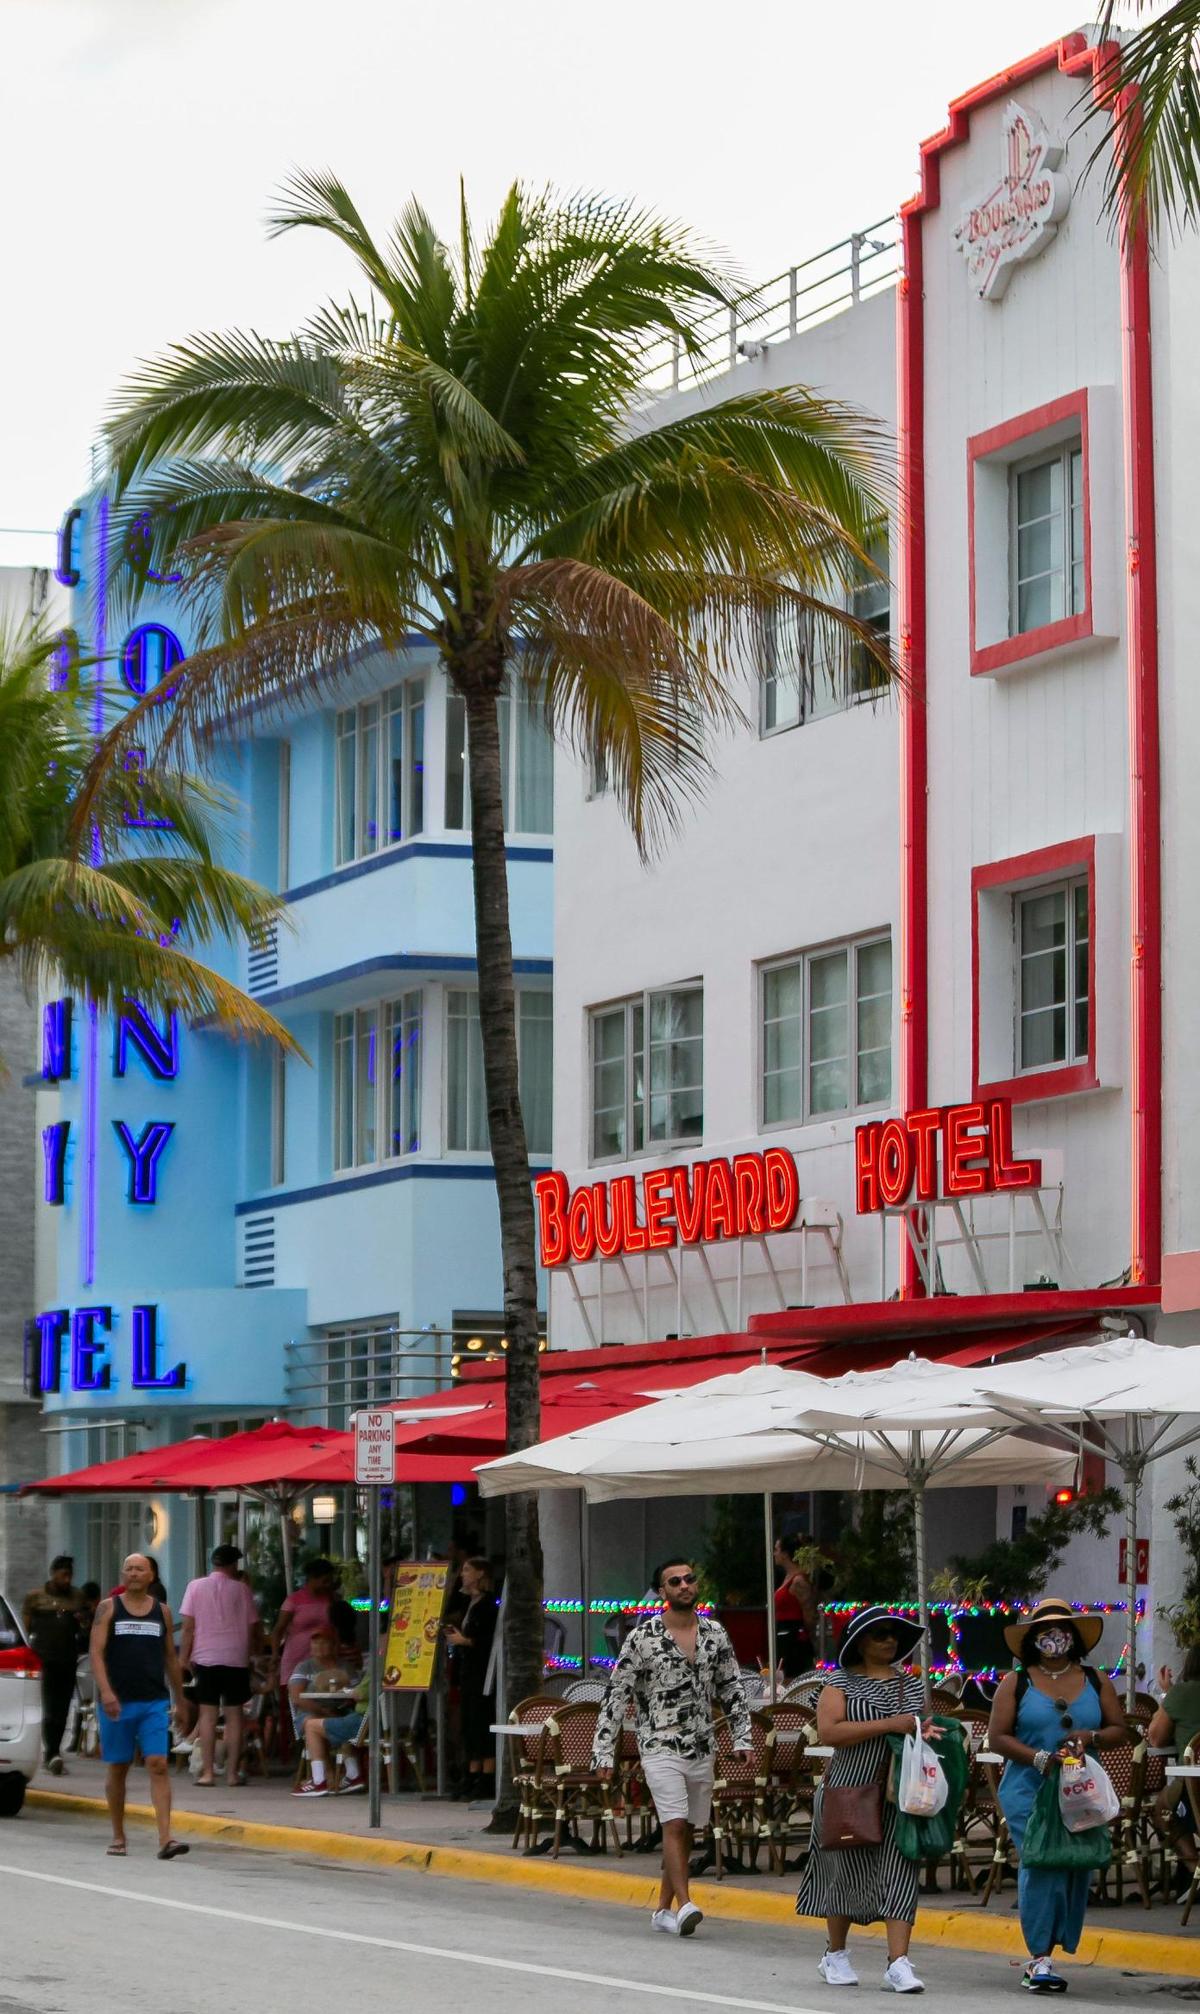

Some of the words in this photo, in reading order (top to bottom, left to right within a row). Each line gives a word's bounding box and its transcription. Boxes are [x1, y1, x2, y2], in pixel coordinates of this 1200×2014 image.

[112, 508, 186, 1205] COLNY
[534, 1147, 799, 1267] BOULEVARD
[855, 1097, 1042, 1215] HOTEL
[368, 1415, 382, 1427] NO
[359, 1430, 391, 1442] PARKING
[368, 1445, 381, 1453] ANY
[368, 1456, 381, 1464] TIME
[1072, 1779, 1095, 1795] CVS
